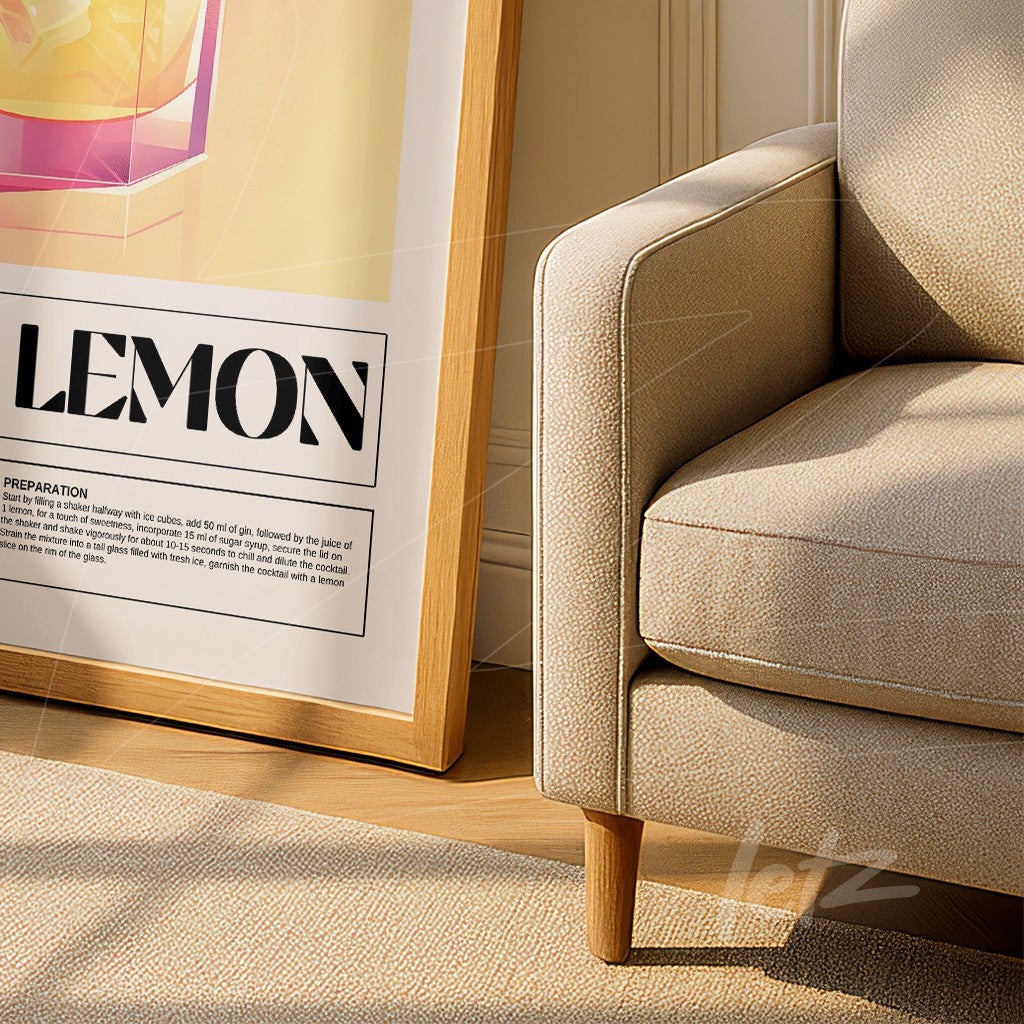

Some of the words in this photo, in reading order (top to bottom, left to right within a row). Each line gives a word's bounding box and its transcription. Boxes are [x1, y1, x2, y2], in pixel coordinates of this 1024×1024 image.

[15, 323, 369, 452] LEMON
[3, 477, 88, 499] PREPARATION
[0, 515, 13, 525] the
[15, 518, 41, 529] shaker
[42, 522, 58, 531] and
[59, 524, 83, 535] shake
[85, 528, 125, 544] vigorously
[127, 534, 139, 543] for
[140, 536, 163, 547] about
[166, 540, 189, 551] 10-15
[191, 545, 226, 556] seconds
[227, 549, 235, 558] to
[237, 550, 254, 561] chill
[256, 554, 272, 563] and
[274, 556, 297, 567] dilute
[299, 559, 313, 569] the
[2, 491, 21, 502] Start
[22, 494, 33, 505] by
[34, 495, 54, 509] filling
[56, 500, 61, 508] a
[63, 500, 90, 512] shaker
[92, 504, 123, 519] halfway
[124, 509, 141, 519] with
[143, 511, 154, 521] ice
[185, 518, 201, 528] add
[203, 520, 214, 530] 50
[216, 522, 227, 532] ml
[228, 524, 237, 533] of
[256, 527, 291, 541] followed
[293, 532, 304, 545] by
[305, 534, 319, 545] the
[320, 536, 341, 551] juice
[343, 540, 353, 550] of
[2, 503, 6, 512] 1
[36, 508, 47, 518] for
[49, 511, 54, 519] a
[56, 512, 78, 522] touch
[80, 515, 88, 524] of
[136, 522, 182, 538] incorporate
[185, 530, 194, 539] 15
[196, 532, 207, 541] ml
[208, 534, 217, 543] of
[219, 536, 242, 548] sugar
[272, 544, 301, 555] secure
[303, 547, 316, 557] the
[319, 549, 329, 559] lid
[331, 551, 342, 561] on
[0, 527, 22, 538] Strain
[24, 531, 37, 541] the
[38, 533, 68, 545] mixture
[69, 537, 84, 548] into
[93, 542, 105, 551] tall
[106, 544, 128, 556] glass
[130, 546, 149, 557] filled
[150, 550, 167, 560] with
[169, 552, 190, 564] fresh
[208, 560, 239, 571] garnish
[241, 563, 255, 574] the
[257, 567, 288, 578] cocktail
[290, 571, 308, 582] with
[310, 575, 316, 583] a
[318, 574, 344, 587] lemon
[18, 543, 28, 551] on
[30, 544, 42, 554] the
[44, 546, 56, 556] rim
[58, 549, 67, 557] of
[68, 550, 81, 559] the
